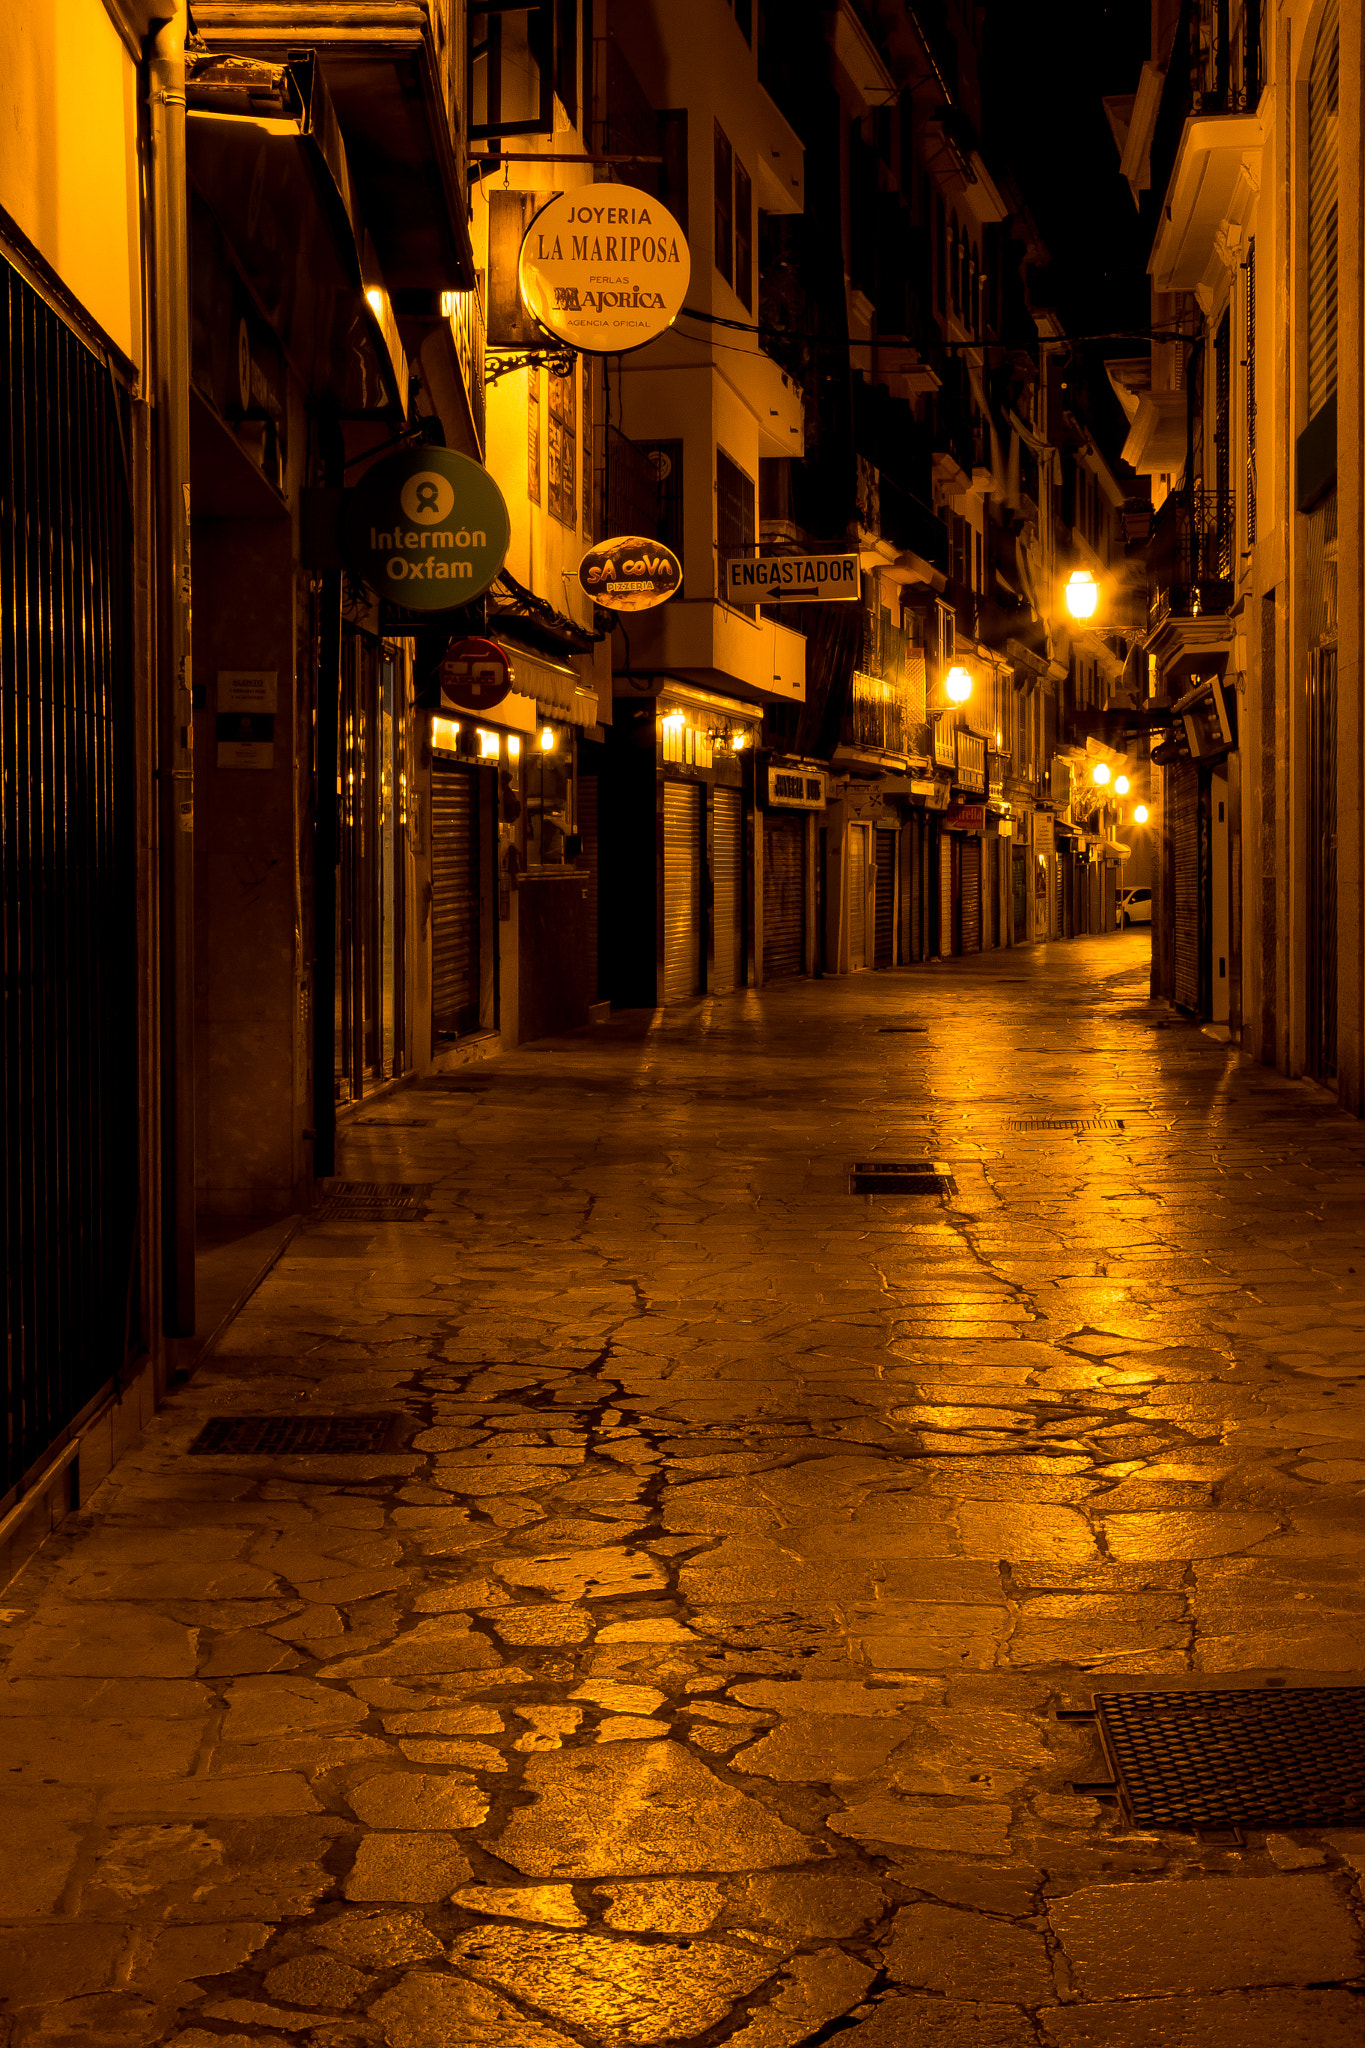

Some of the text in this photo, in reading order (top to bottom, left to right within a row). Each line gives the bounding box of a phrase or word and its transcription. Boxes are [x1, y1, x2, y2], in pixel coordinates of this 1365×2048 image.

[567, 207, 652, 225] JOYERIA
[537, 234, 680, 263] LA MARIPOSA
[589, 276, 630, 285] PERLAS
[567, 319, 651, 328] AGENCIA OFICIAL
[370, 526, 487, 550] Intermón
[386, 556, 473, 580] Oxfam
[587, 559, 617, 584] SA
[732, 560, 854, 585] ENGASTADOR
[606, 581, 655, 592] PIZZERIA
[444, 676, 496, 685] PASCUCCI
